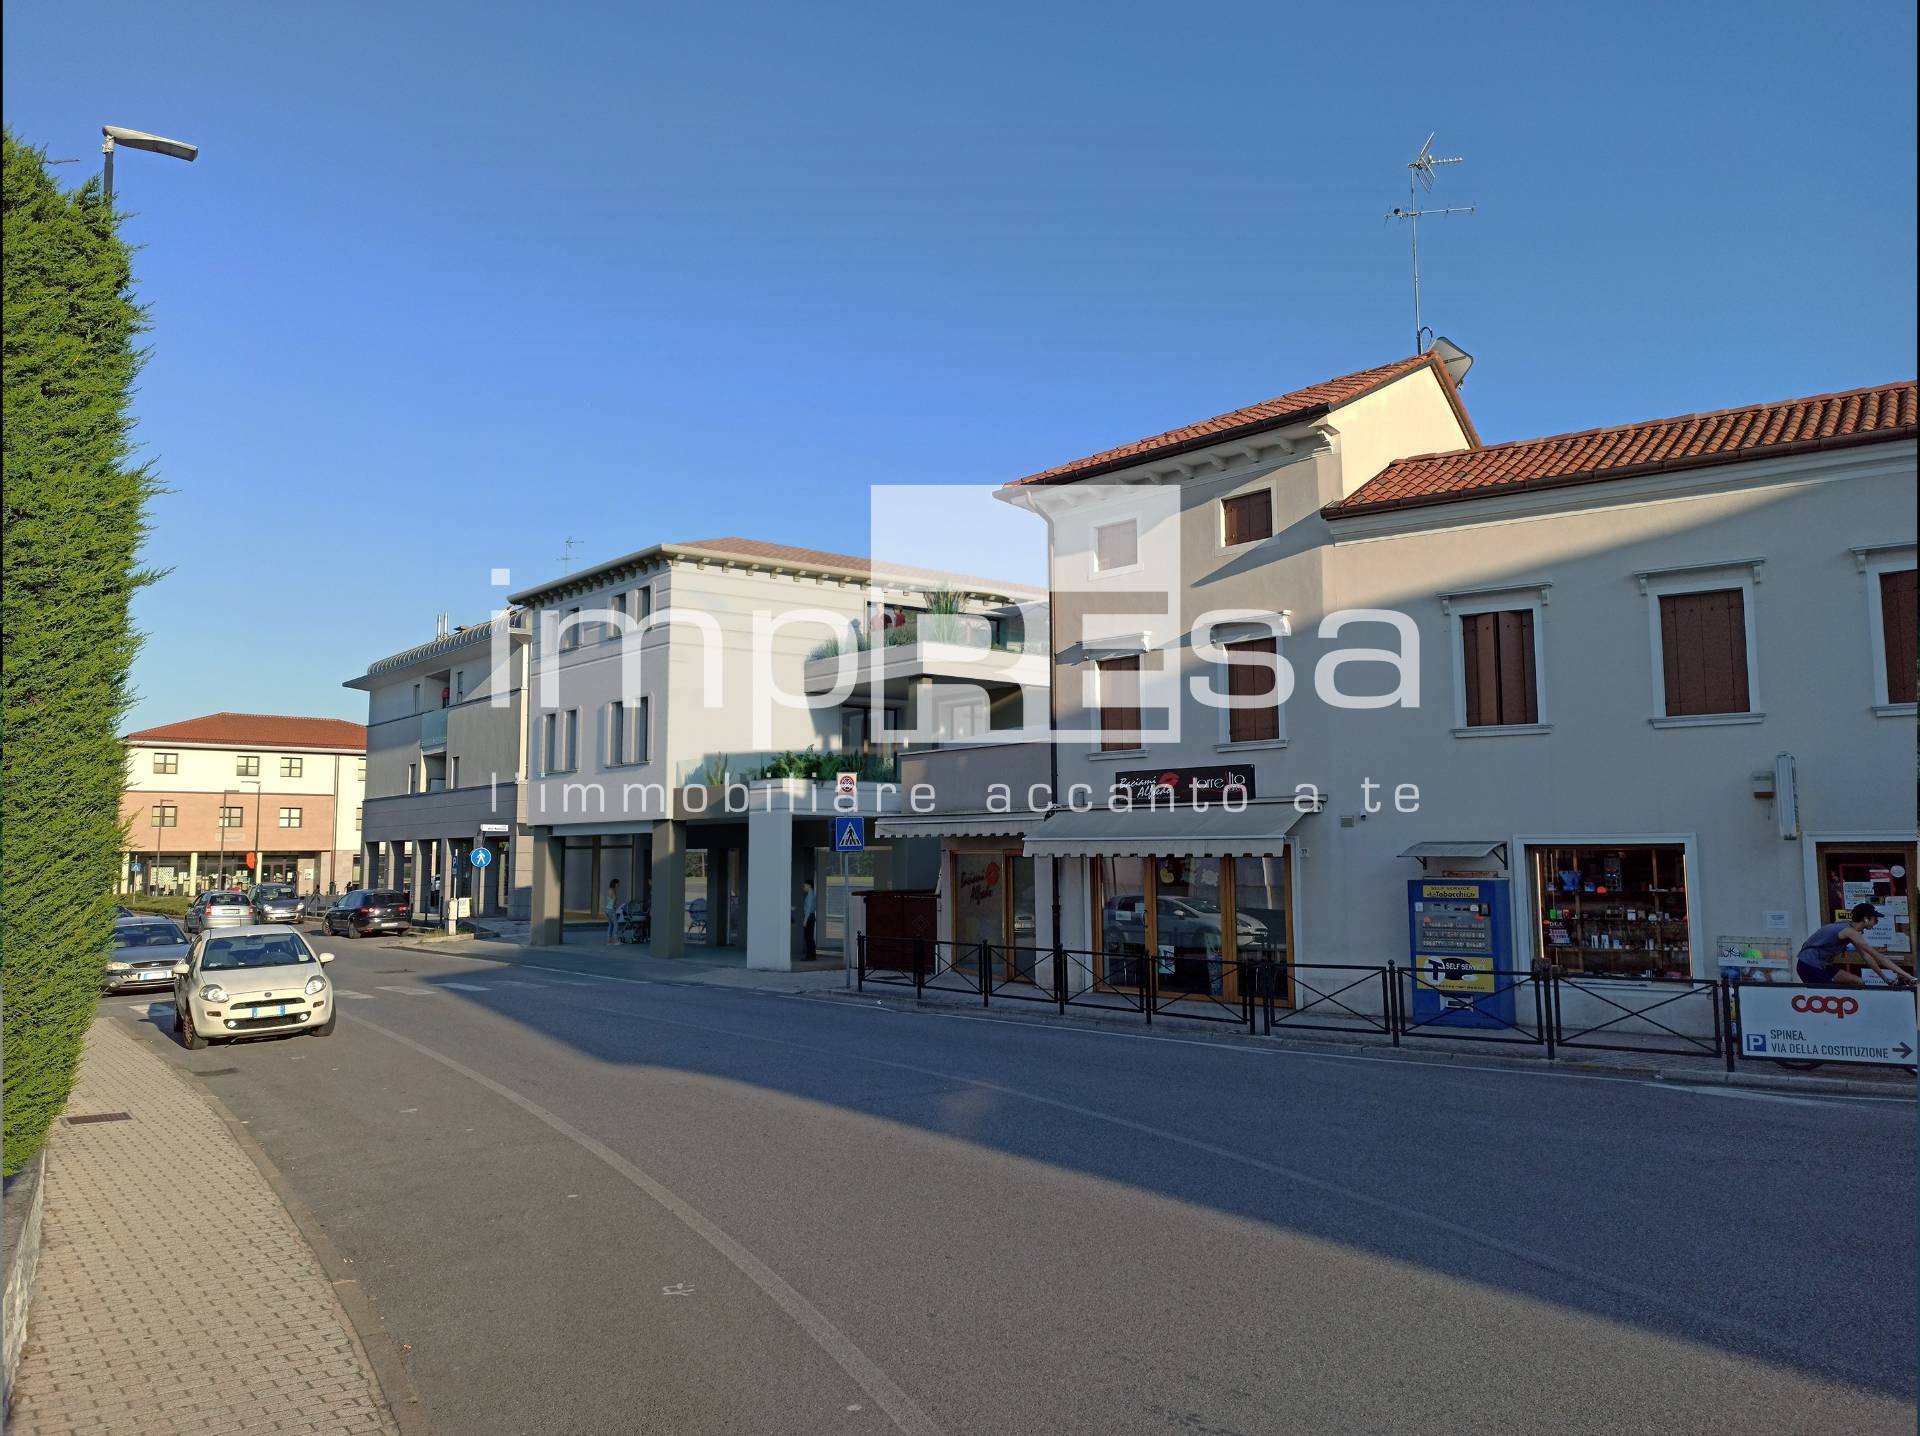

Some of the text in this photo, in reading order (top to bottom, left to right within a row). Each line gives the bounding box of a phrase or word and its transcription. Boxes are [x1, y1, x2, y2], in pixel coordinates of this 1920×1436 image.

[1791, 995, 1859, 1019] coop
[1771, 1043, 1889, 1059] VIA DELLA COSTITUZIONE
